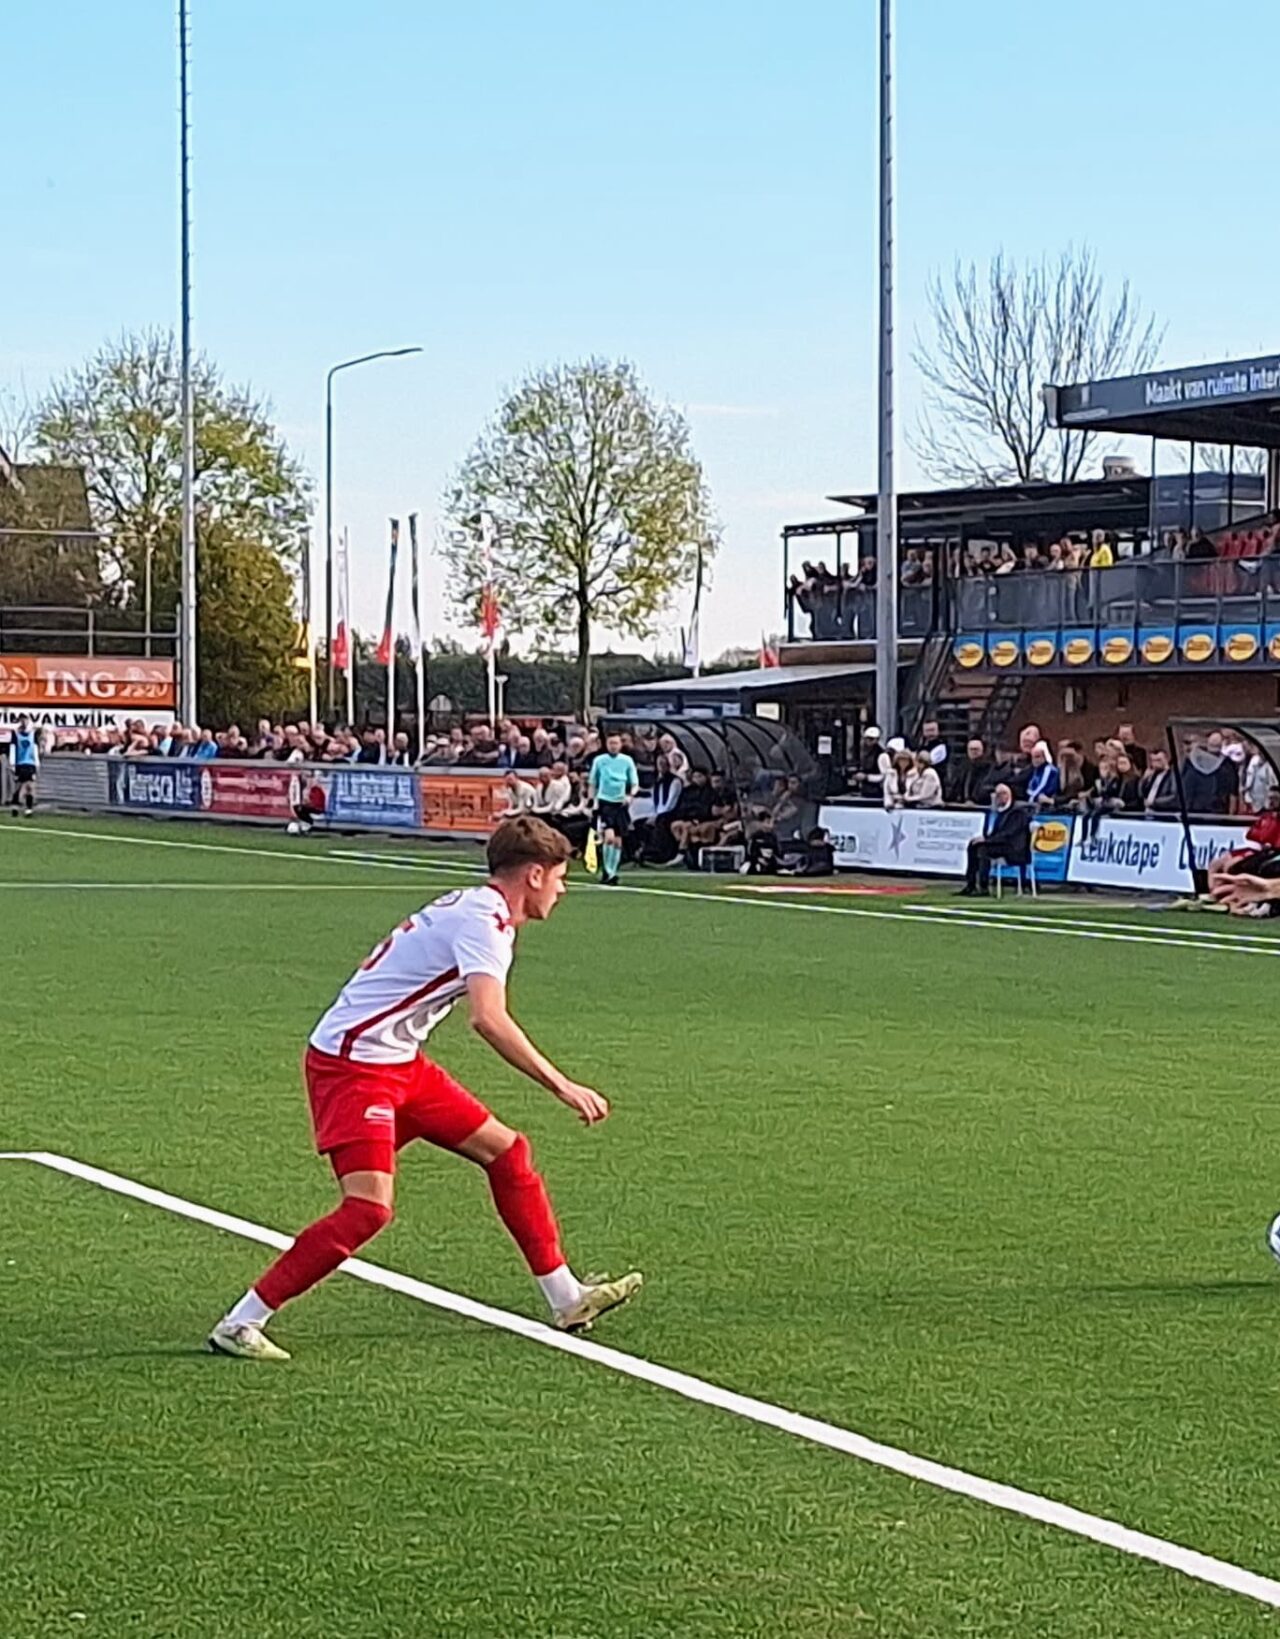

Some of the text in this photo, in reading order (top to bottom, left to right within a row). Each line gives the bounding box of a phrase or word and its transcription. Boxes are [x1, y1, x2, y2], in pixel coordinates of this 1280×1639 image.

[44, 669, 118, 698] ING
[29, 711, 67, 727] VAN
[1078, 831, 1160, 875] Leukotape
